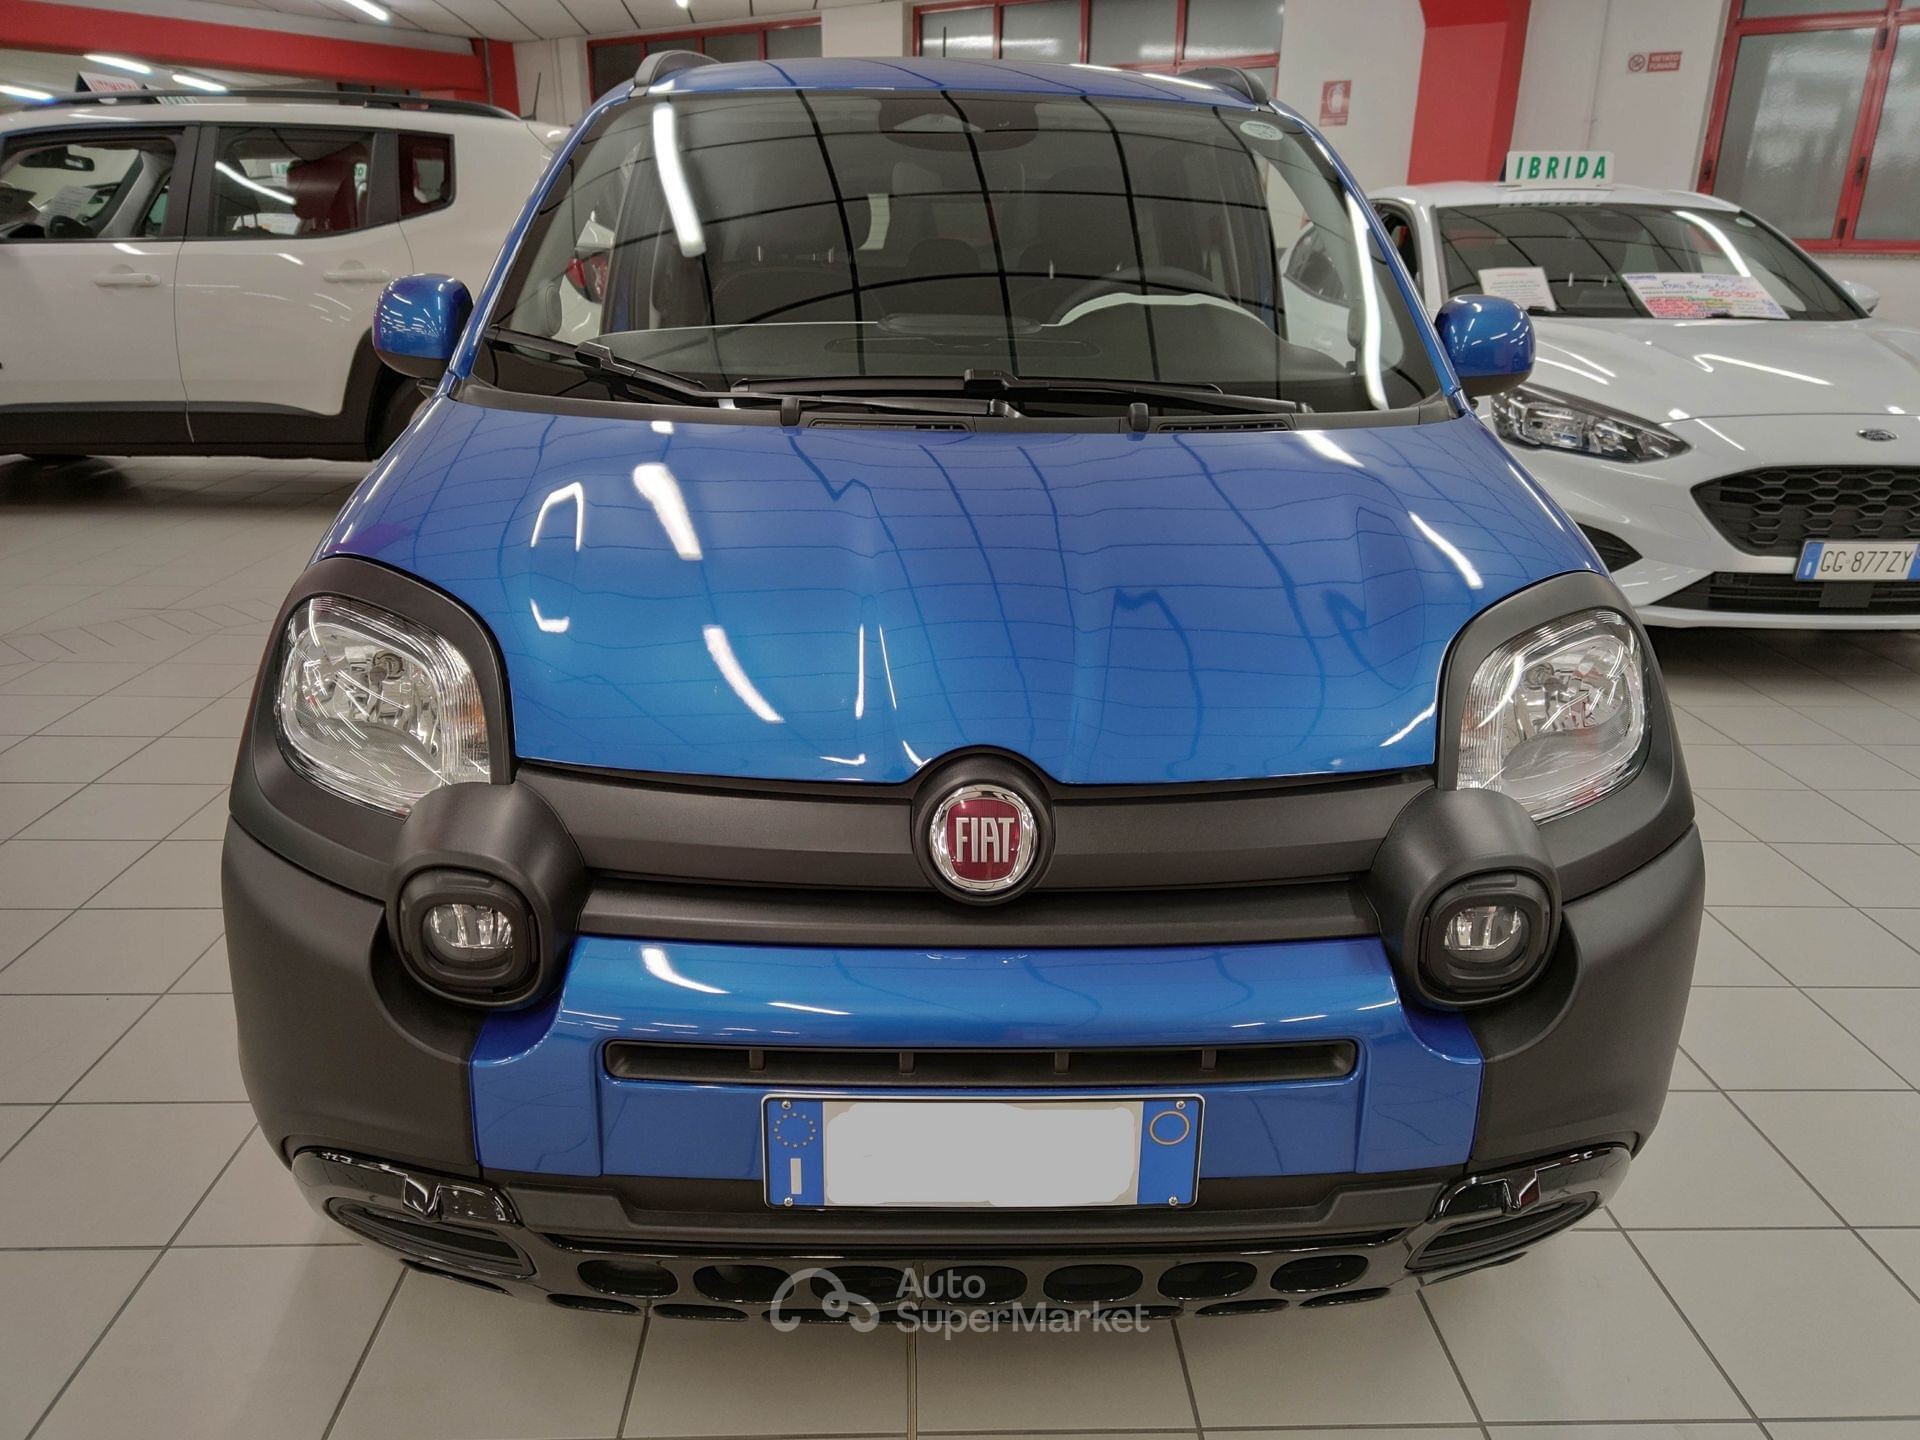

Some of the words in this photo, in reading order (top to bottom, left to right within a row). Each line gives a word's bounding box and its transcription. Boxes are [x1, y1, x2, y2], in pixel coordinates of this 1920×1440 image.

[1516, 156, 1606, 179] IBRIDA
[1820, 550, 1846, 572] GG
[1851, 550, 1913, 573] 877ZY
[955, 816, 1015, 864] FIAT
[790, 1158, 802, 1195] I
